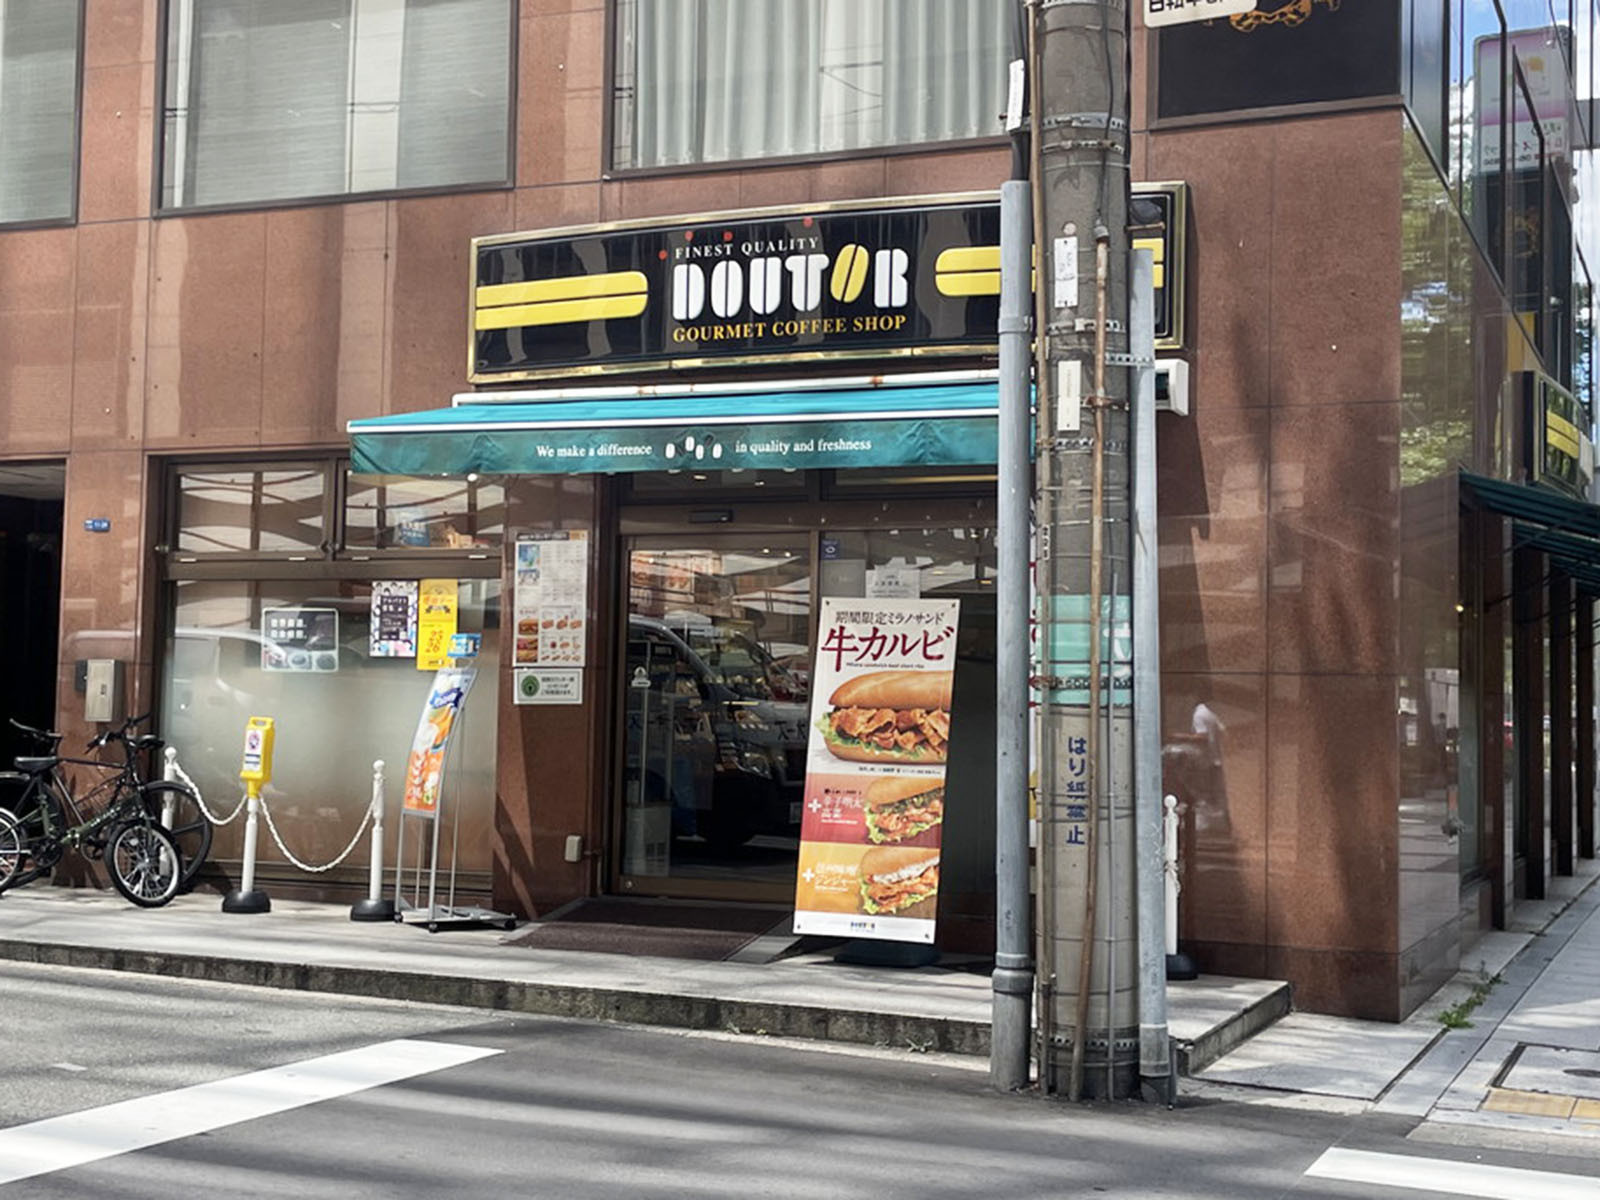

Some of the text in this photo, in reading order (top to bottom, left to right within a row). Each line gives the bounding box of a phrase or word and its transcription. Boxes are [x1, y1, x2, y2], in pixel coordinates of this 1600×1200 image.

[675, 236, 819, 259] FINEST QUALITY
[673, 244, 909, 321] DOUTOR
[673, 315, 907, 343] GOURMET COFFEE SHOP
[536, 445, 554, 457] We
[557, 445, 586, 457] make
[597, 443, 652, 457] difference
[735, 438, 872, 455] in quality and freshness
[835, 611, 945, 625] 期間限定ミラノサンド
[821, 625, 955, 673] 牛カルビ
[1065, 736, 1087, 845] はり紙禁止
